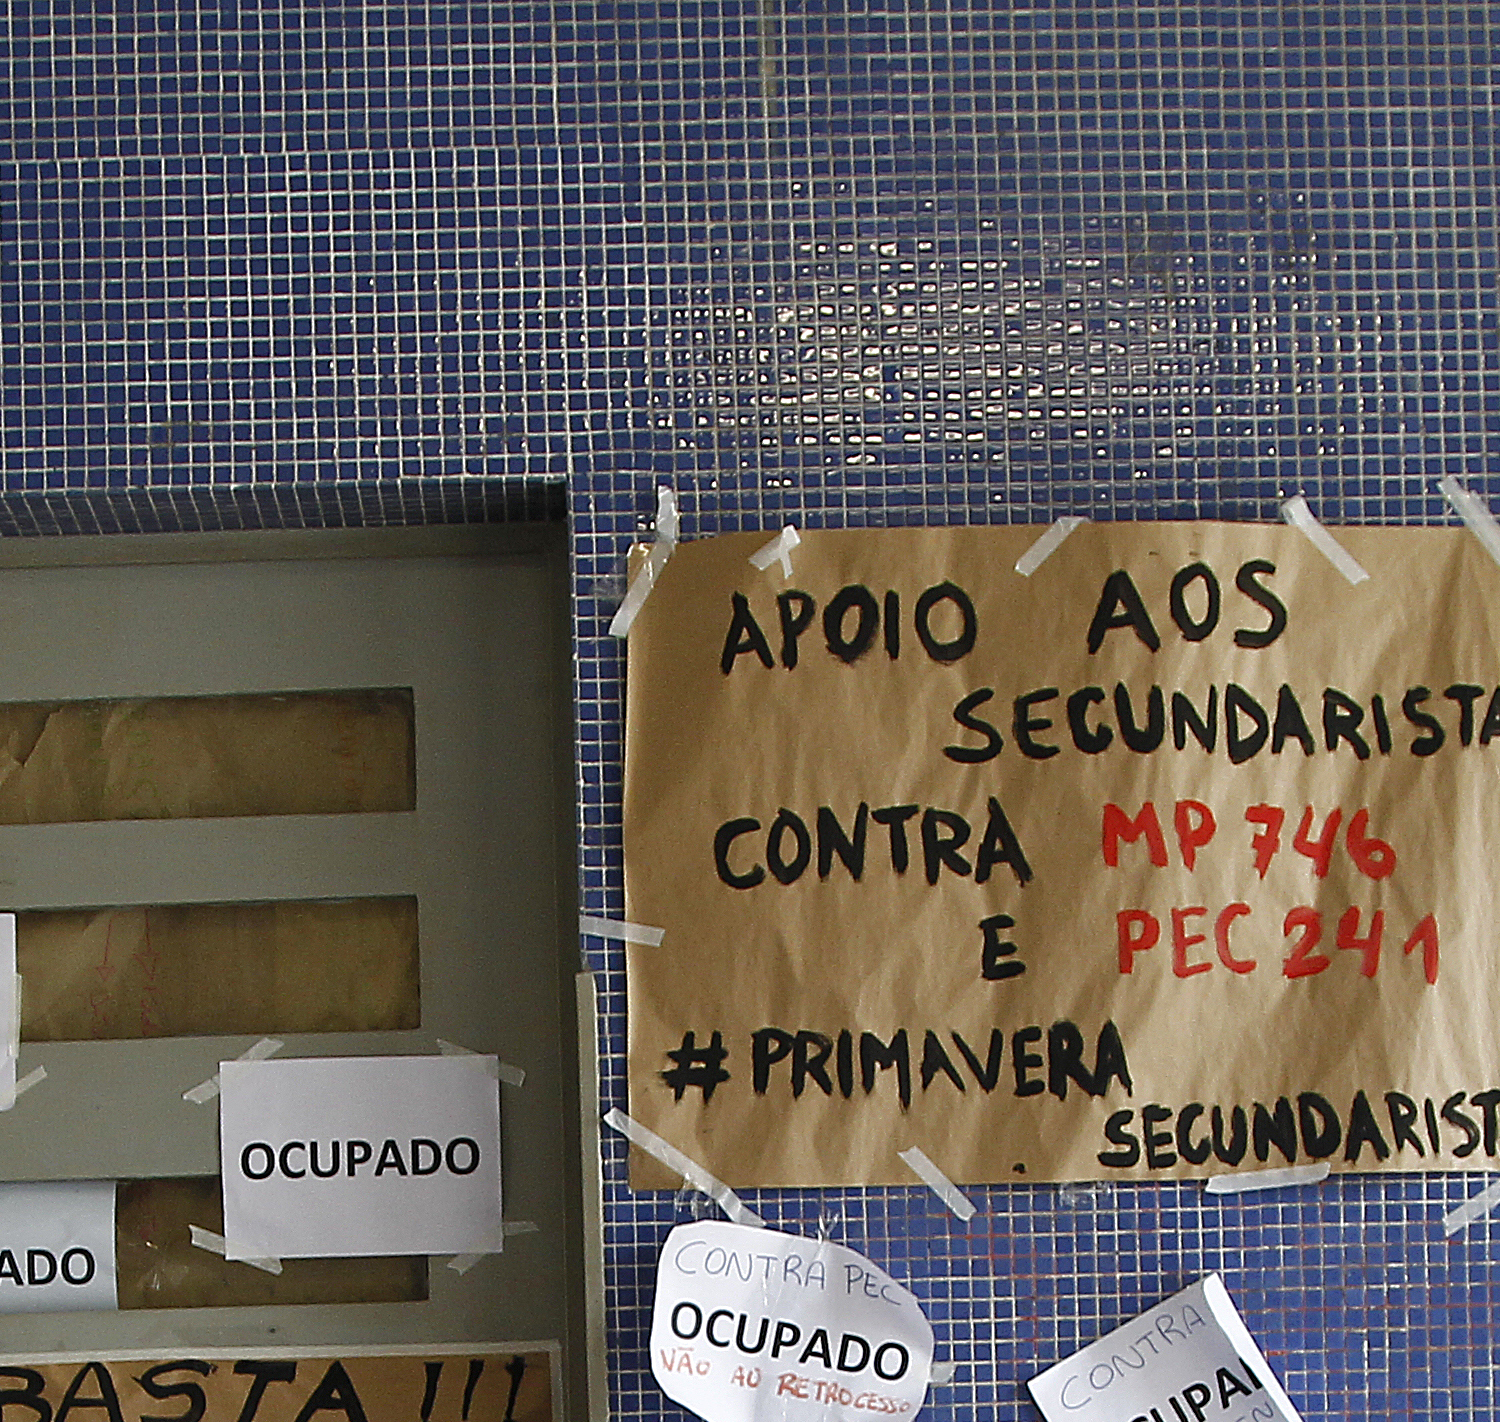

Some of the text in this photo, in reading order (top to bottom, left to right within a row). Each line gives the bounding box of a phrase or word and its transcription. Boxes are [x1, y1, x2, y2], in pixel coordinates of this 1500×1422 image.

[719, 558, 1288, 676] APOIO AOS
[712, 797, 1398, 889] CONTRA MP 746
[980, 902, 1441, 985] E PEC 241
[239, 1135, 481, 1181] OCUPADO
[674, 1239, 903, 1307] CONTRA PEC
[659, 1346, 711, 1377] NÃO
[776, 1373, 912, 1414] RETROCESSO
[670, 1301, 909, 1382] OCUPADO
[1060, 1302, 1208, 1411] CONTRA
